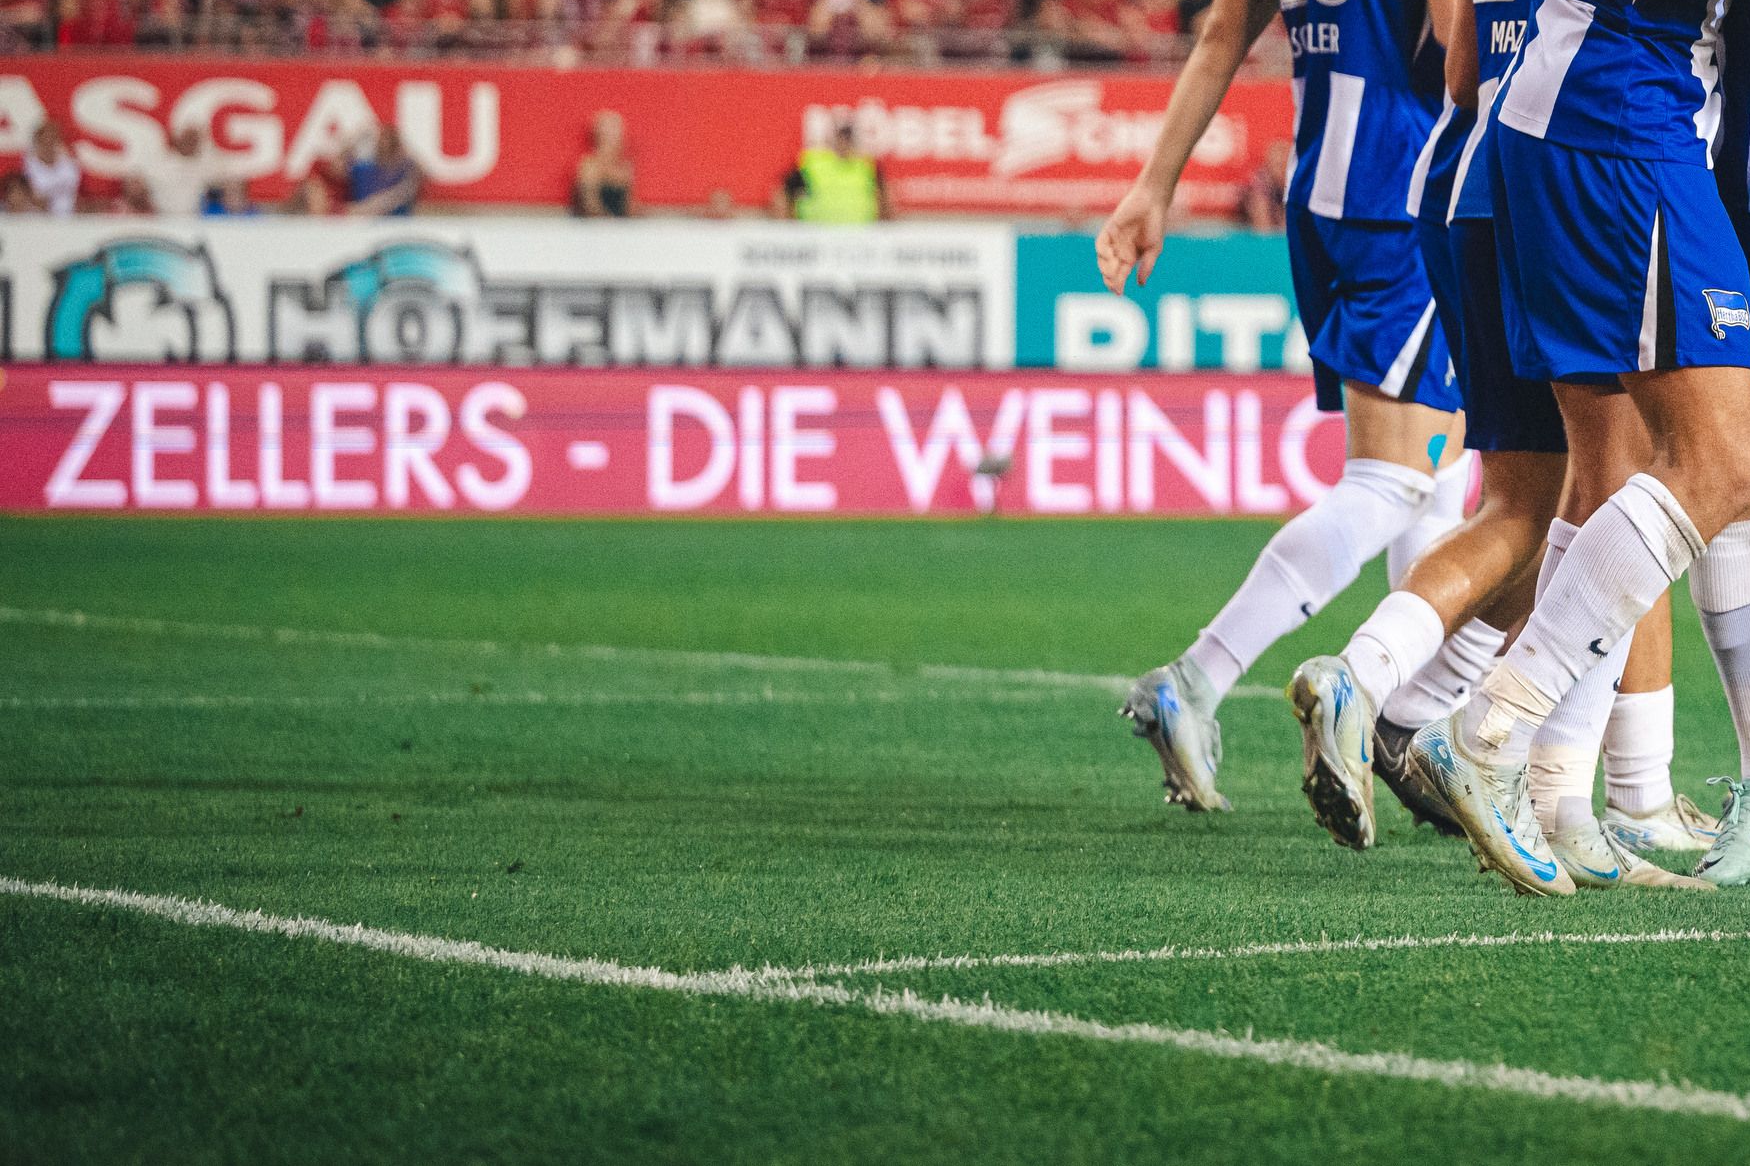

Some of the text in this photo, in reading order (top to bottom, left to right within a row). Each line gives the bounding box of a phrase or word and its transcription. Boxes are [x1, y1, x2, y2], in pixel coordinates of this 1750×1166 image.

[1490, 20, 1527, 54] MAZ
[268, 277, 986, 367] HOFFMANN
[44, 380, 534, 511] ZELLERS
[647, 384, 837, 512] DIE
